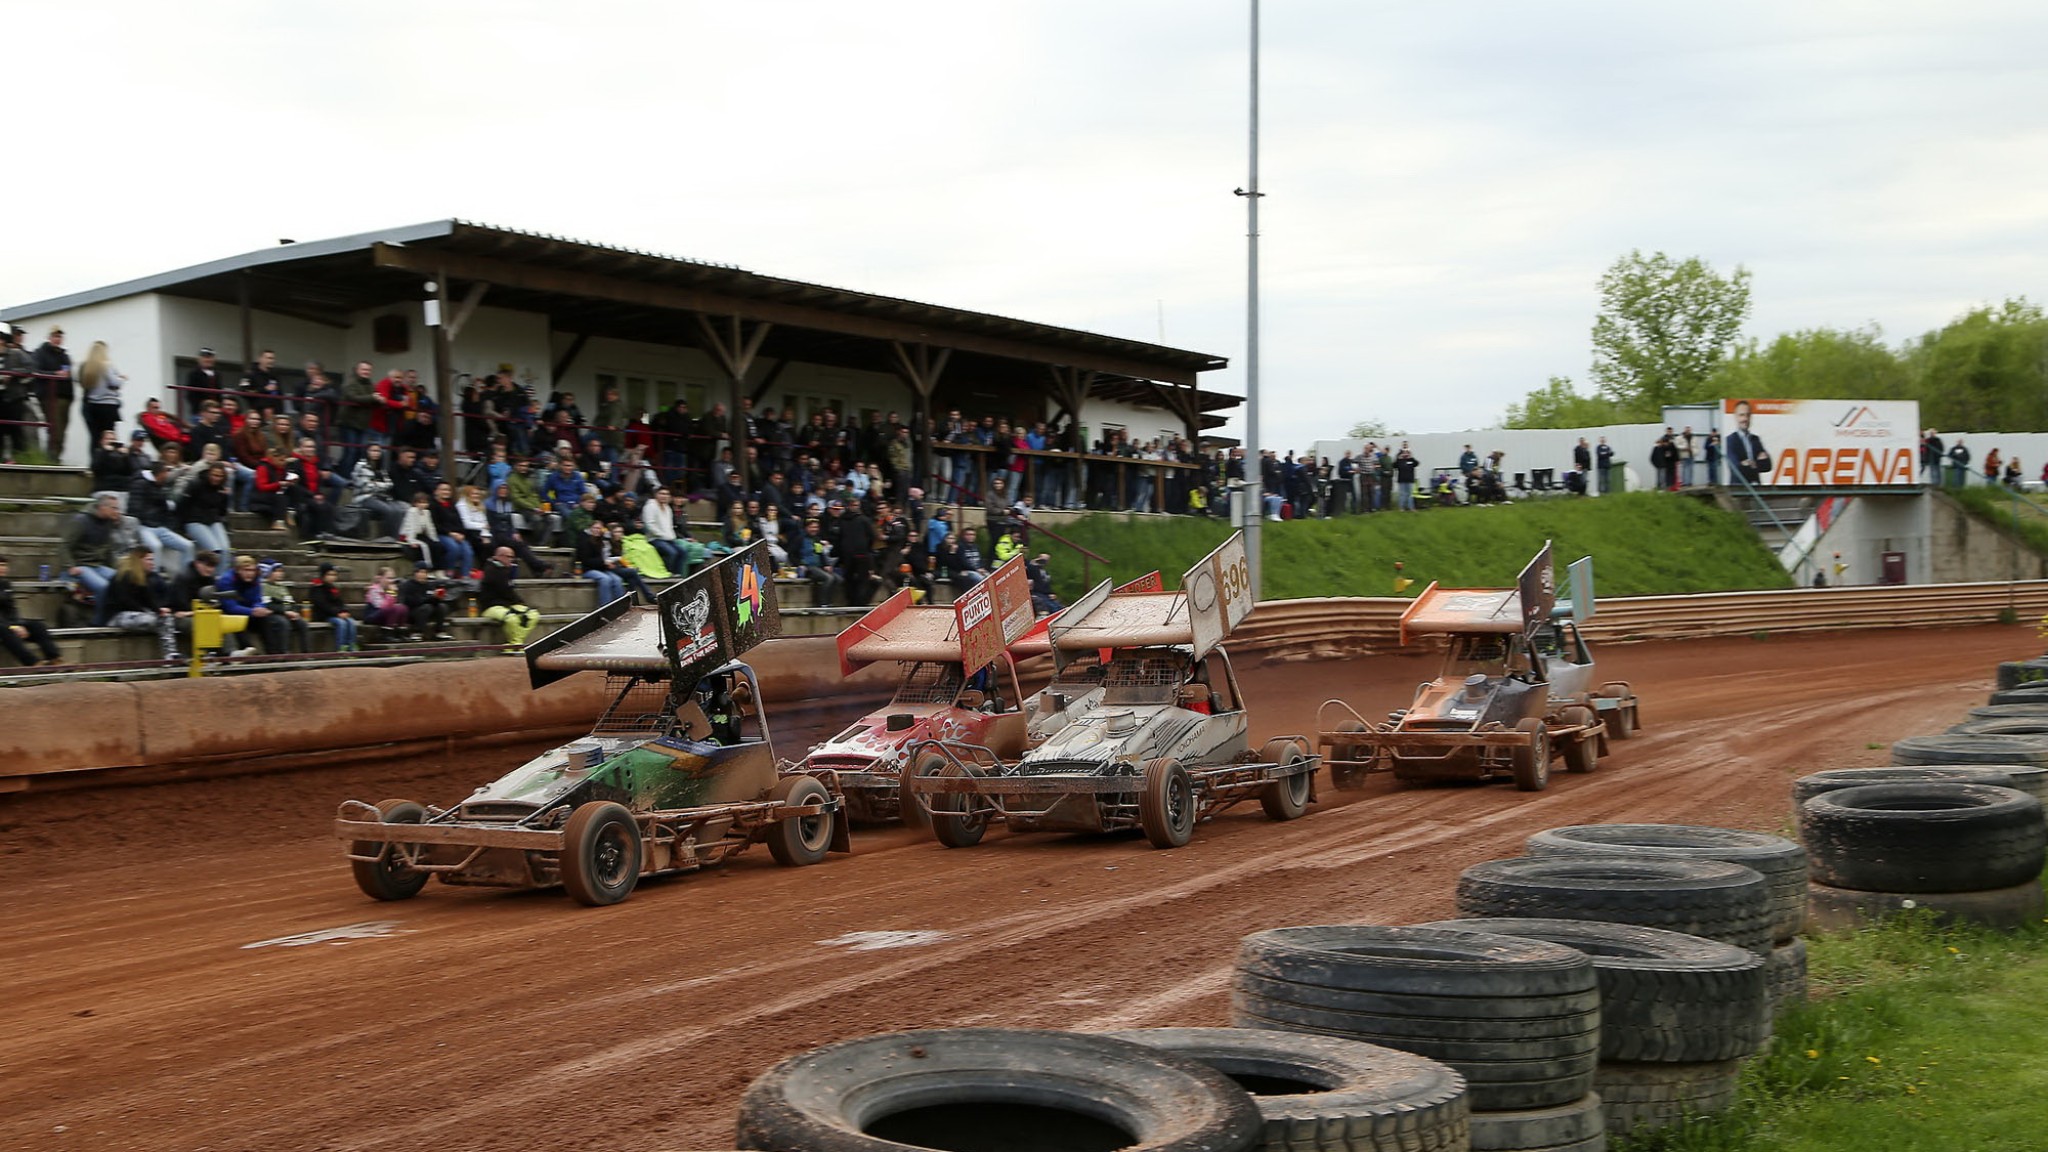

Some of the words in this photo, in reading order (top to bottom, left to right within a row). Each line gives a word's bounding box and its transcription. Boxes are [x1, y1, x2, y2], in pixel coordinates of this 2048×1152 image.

[1772, 448, 1912, 485] ARENA
[740, 564, 761, 618] 4
[1222, 556, 1249, 605] 696
[964, 596, 990, 623] PUNTO
